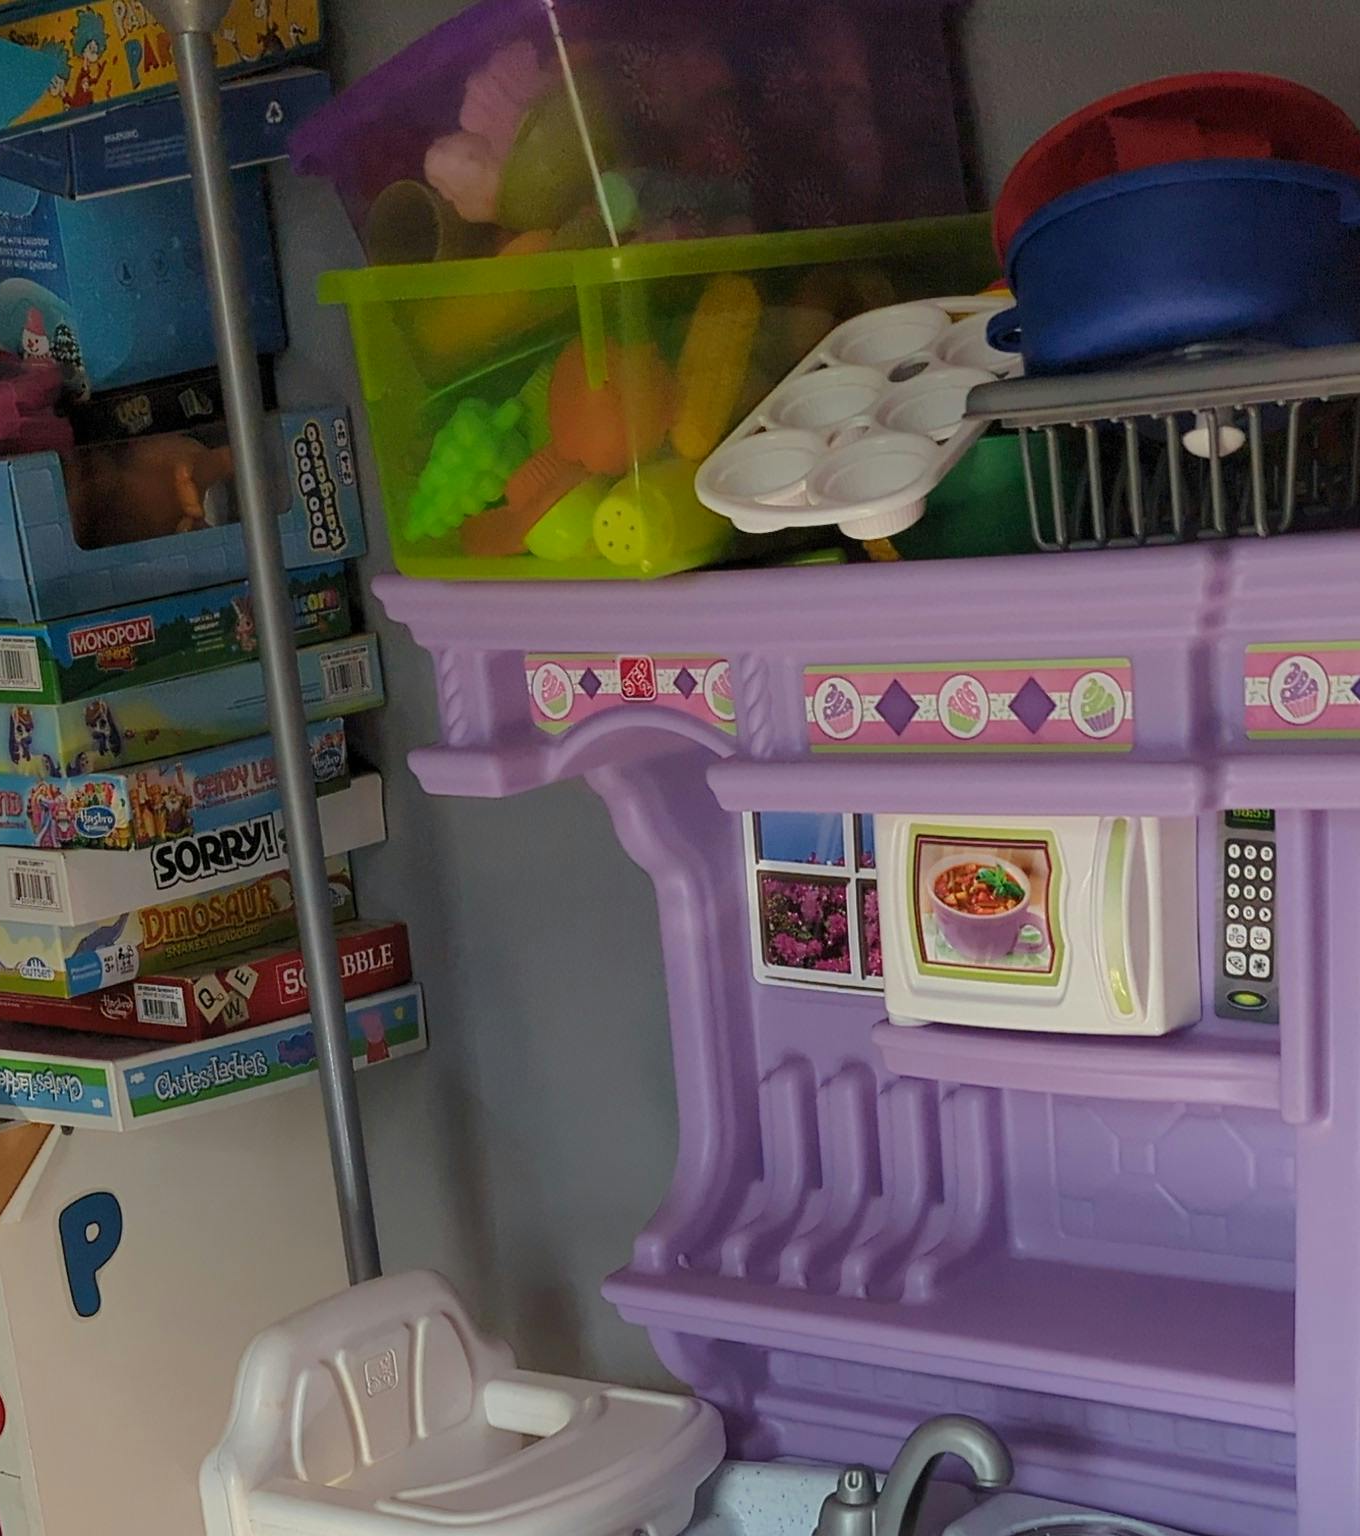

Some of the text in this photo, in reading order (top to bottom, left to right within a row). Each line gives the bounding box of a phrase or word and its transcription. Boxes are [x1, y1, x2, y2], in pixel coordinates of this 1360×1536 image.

[304, 422, 346, 551] Kangaroo
[72, 620, 151, 655] MONOPOLY
[153, 818, 278, 885] SORRY!
[141, 884, 278, 949] DINOSAUR
[59, 1190, 124, 1319] P
